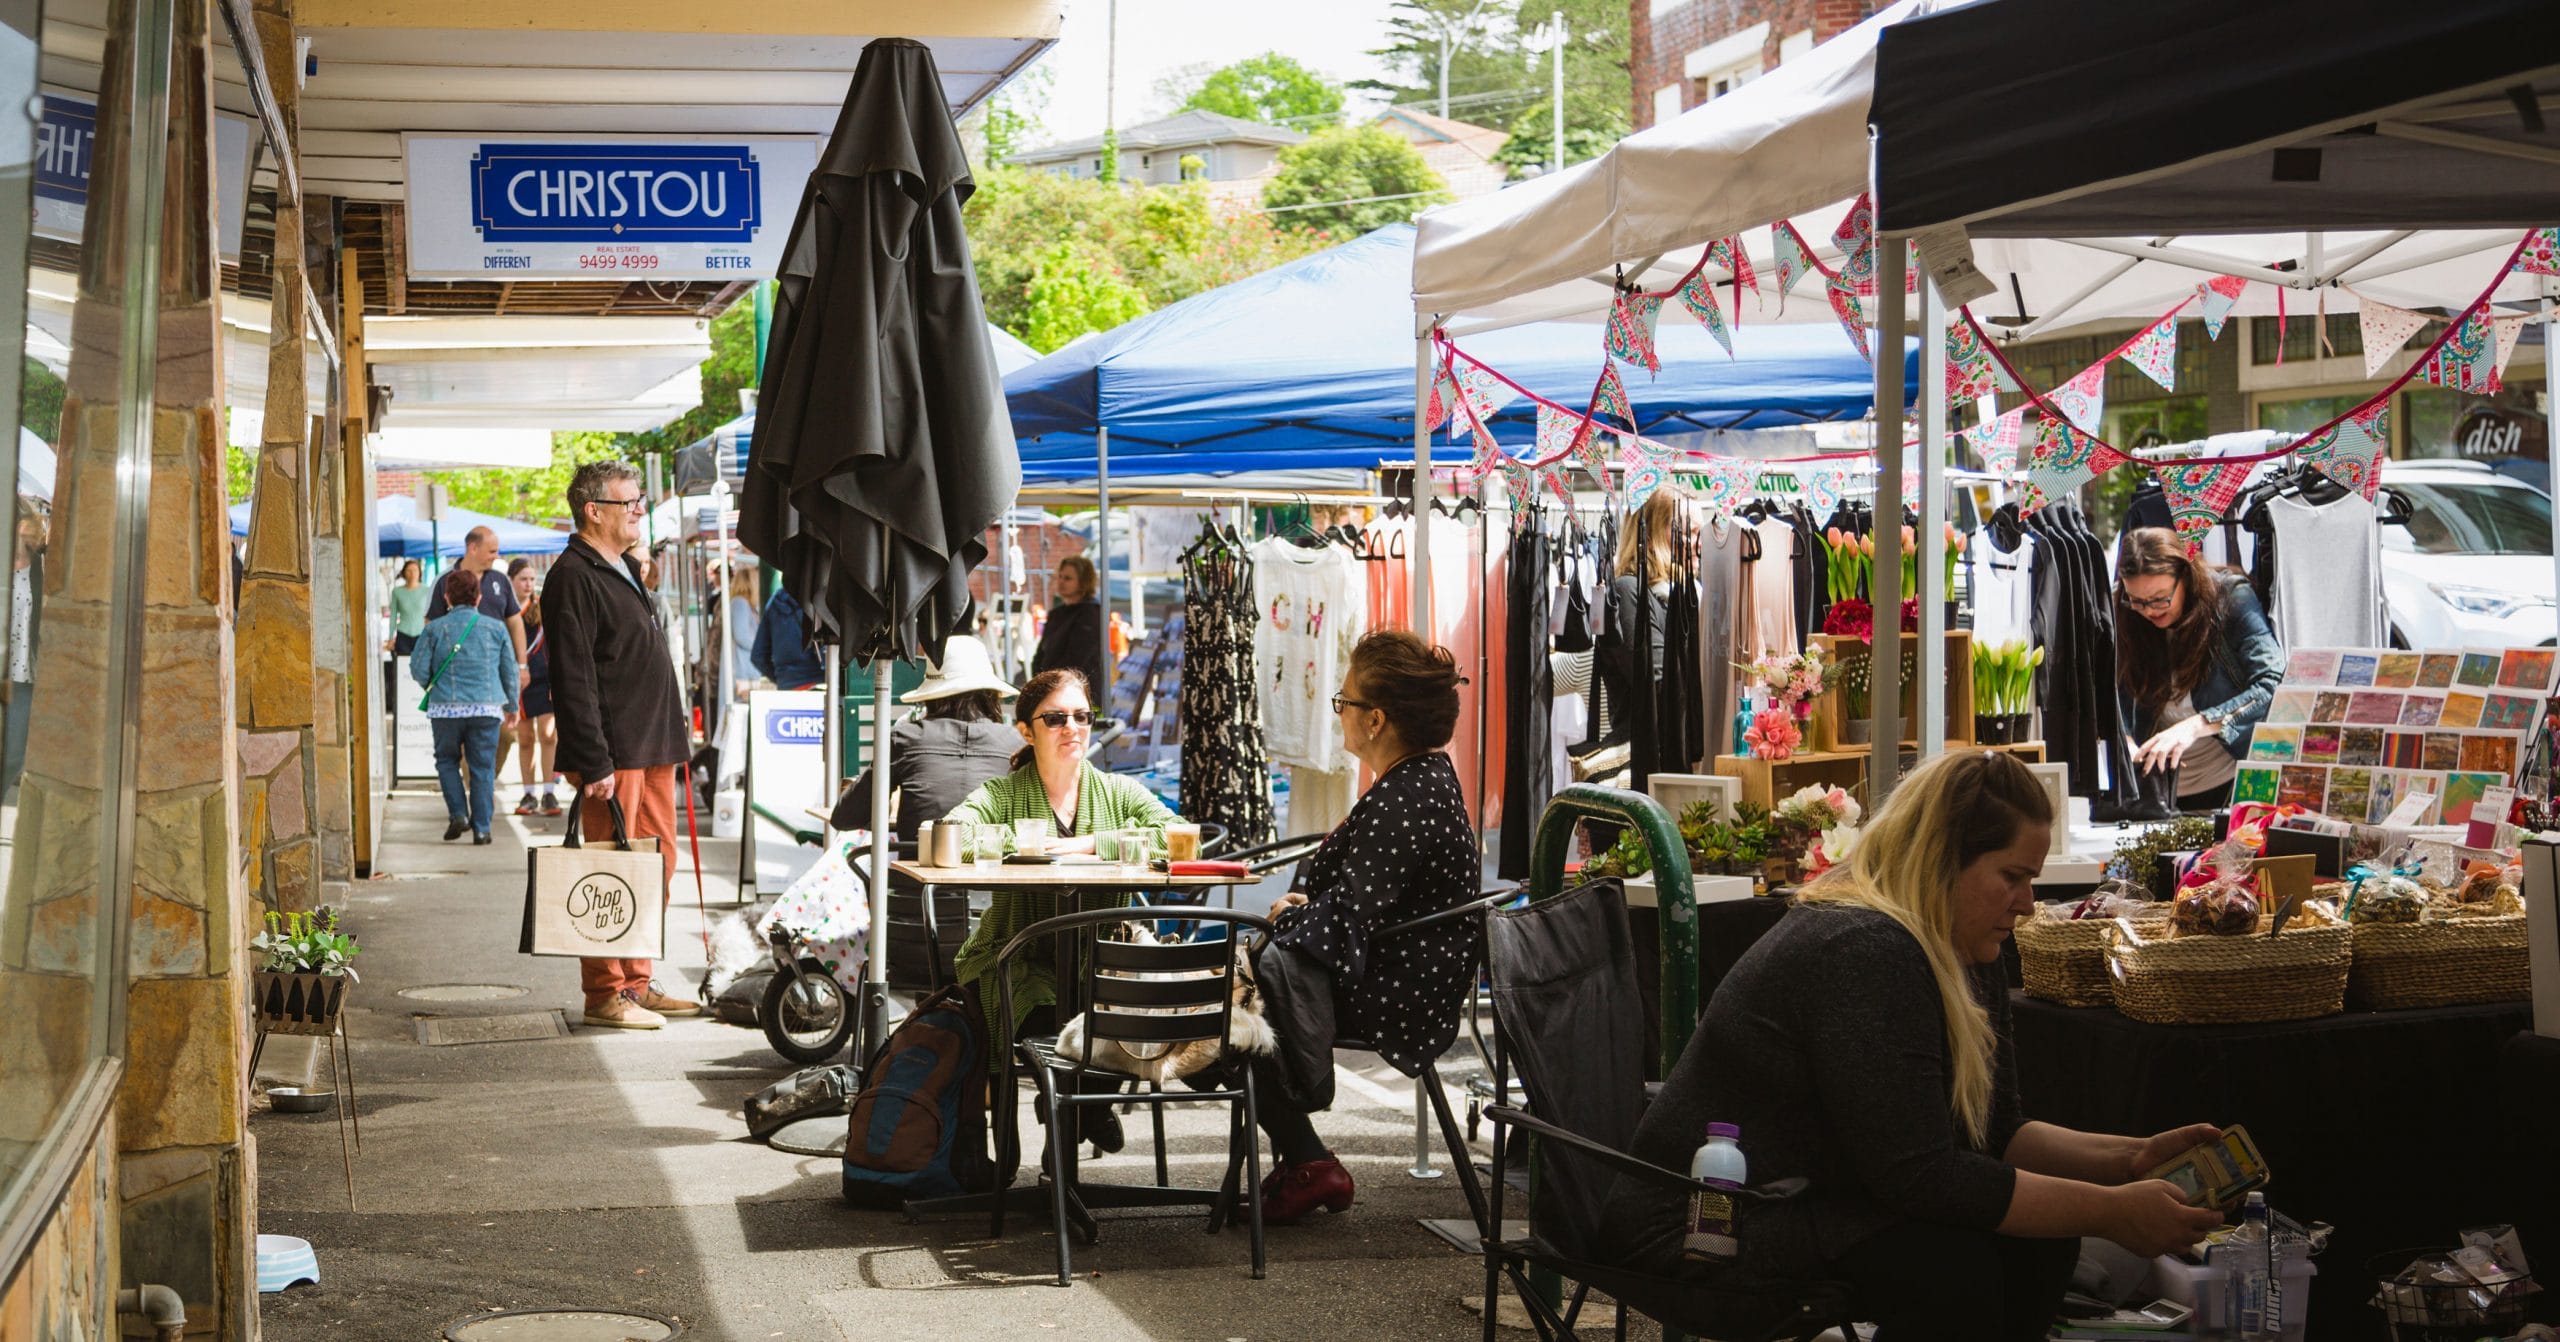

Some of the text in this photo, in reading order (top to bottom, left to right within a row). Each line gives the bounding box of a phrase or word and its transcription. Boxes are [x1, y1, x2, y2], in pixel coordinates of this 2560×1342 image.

[507, 170, 727, 217] CHRISTOU
[484, 256, 531, 269] DIFFERENT
[579, 255, 659, 269] 9499 4999
[705, 256, 752, 269] BETTER
[2465, 418, 2522, 455] dish
[567, 884, 622, 918] Shop
[595, 906, 625, 930] to it
